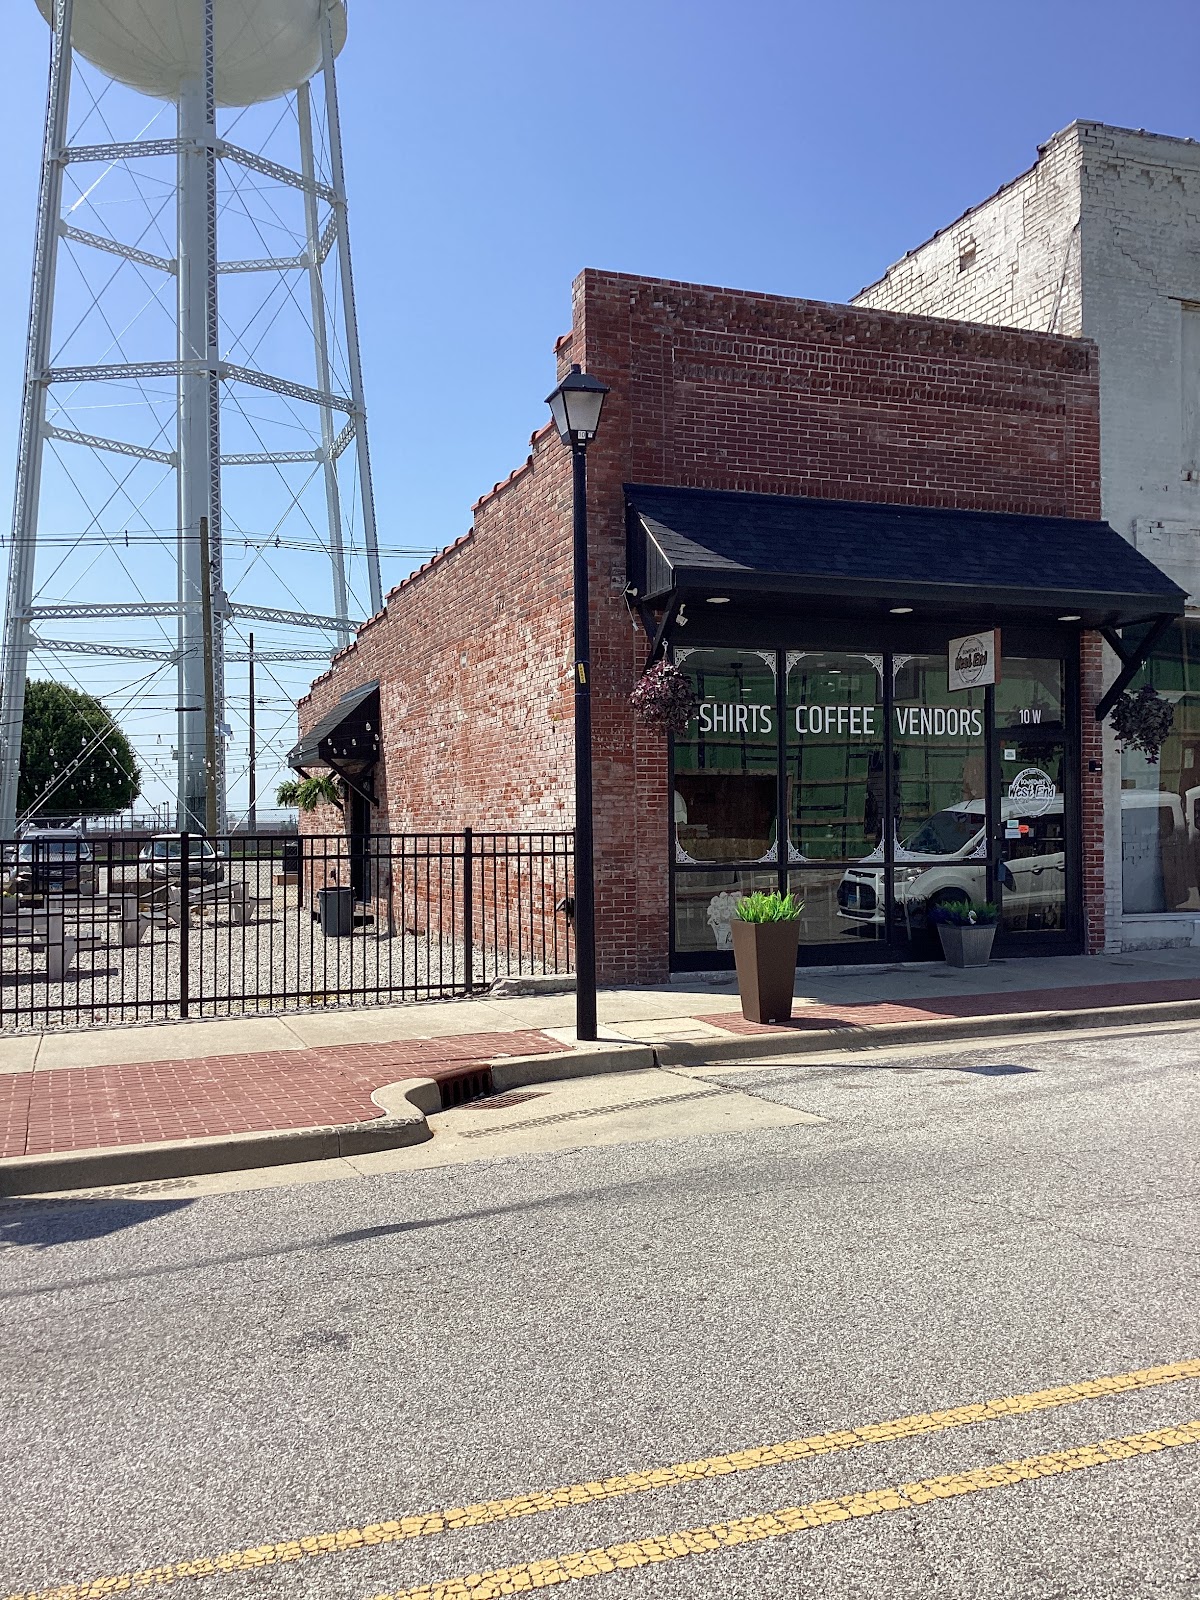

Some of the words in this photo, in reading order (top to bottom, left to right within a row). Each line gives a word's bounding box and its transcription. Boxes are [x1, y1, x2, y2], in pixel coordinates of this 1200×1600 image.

[973, 650, 988, 667] End
[795, 705, 875, 734] COFFEE
[896, 707, 982, 736] VENDORS
[1018, 709, 1030, 724] 10
[1032, 709, 1042, 724] W
[1008, 784, 1034, 800] West
[1035, 783, 1056, 800] End
